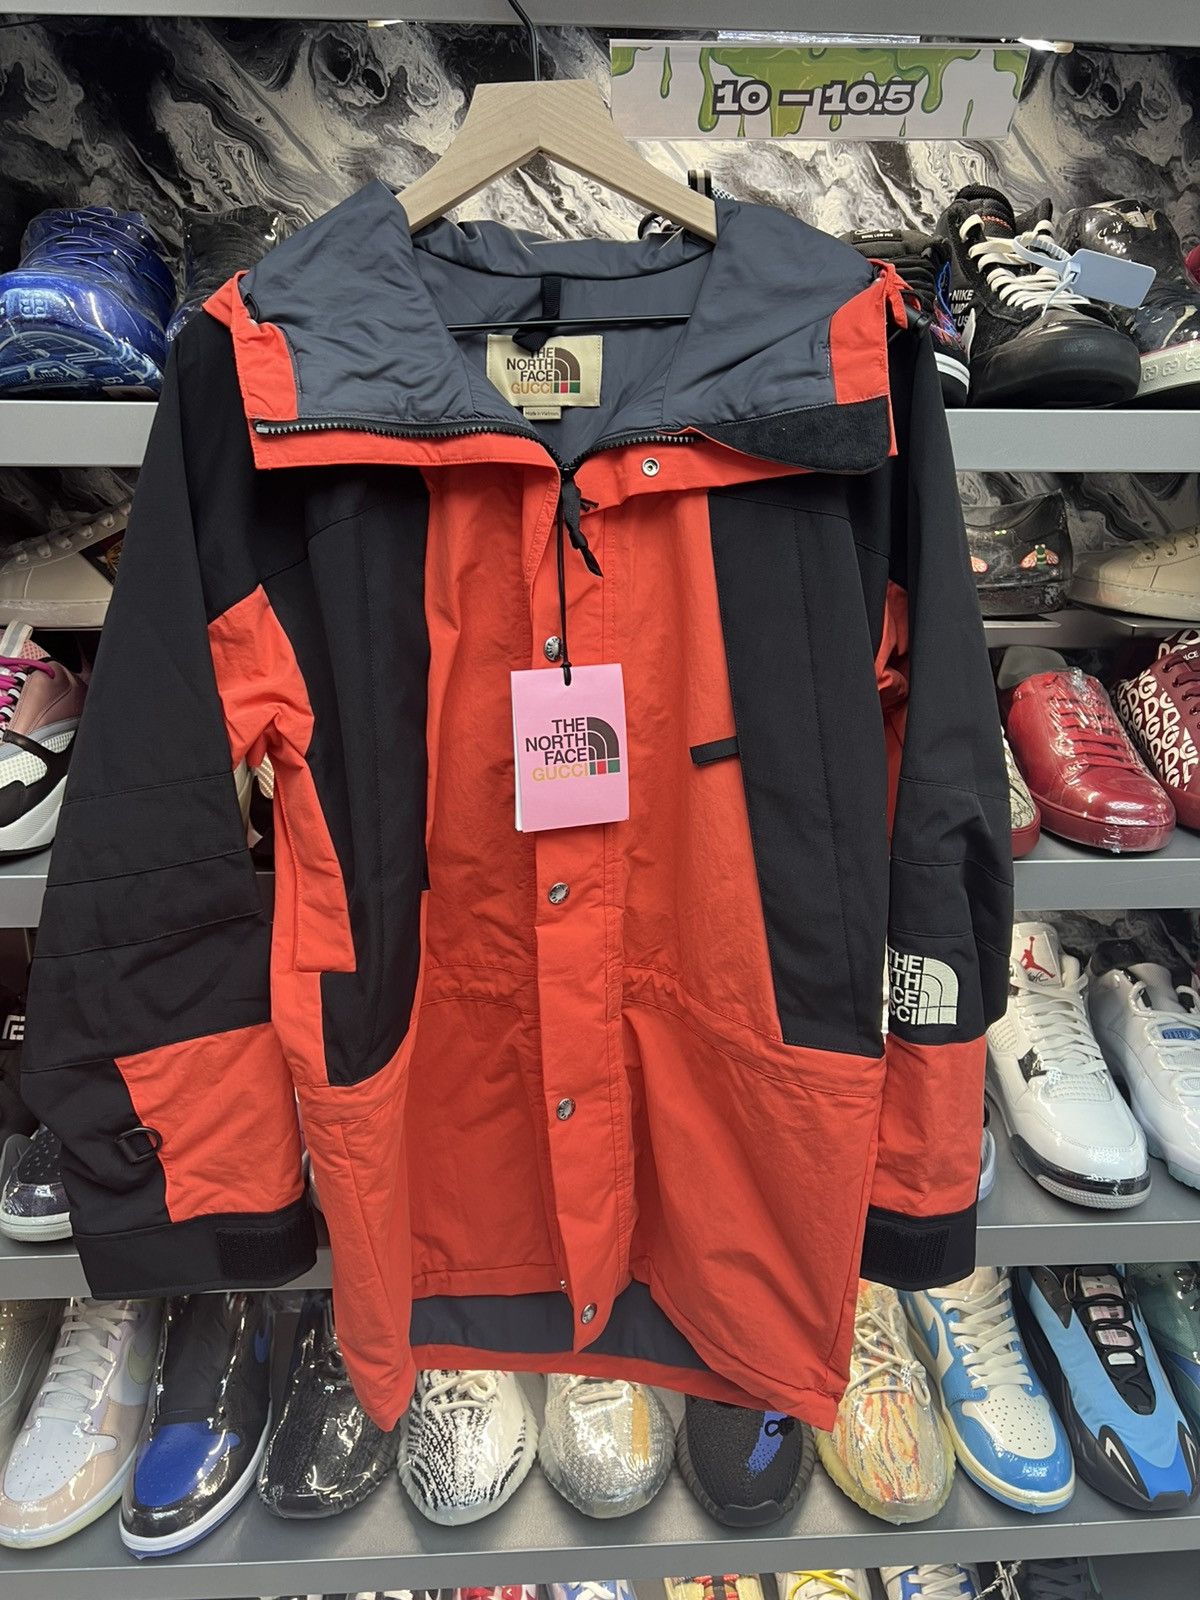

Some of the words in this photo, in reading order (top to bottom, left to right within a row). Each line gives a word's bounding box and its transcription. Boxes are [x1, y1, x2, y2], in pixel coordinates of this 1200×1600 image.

[713, 80, 771, 115] 10
[819, 80, 917, 115] 10.5
[952, 290, 974, 300] NIKE
[531, 347, 554, 359] HE
[506, 358, 554, 370] NORTH
[520, 370, 553, 382] FACE
[511, 382, 553, 395] GUCCI
[551, 717, 586, 734] THE
[525, 732, 587, 752] NORTH
[544, 747, 588, 766] FACE
[532, 762, 589, 782] GUCCI
[887, 946, 923, 974] THE
